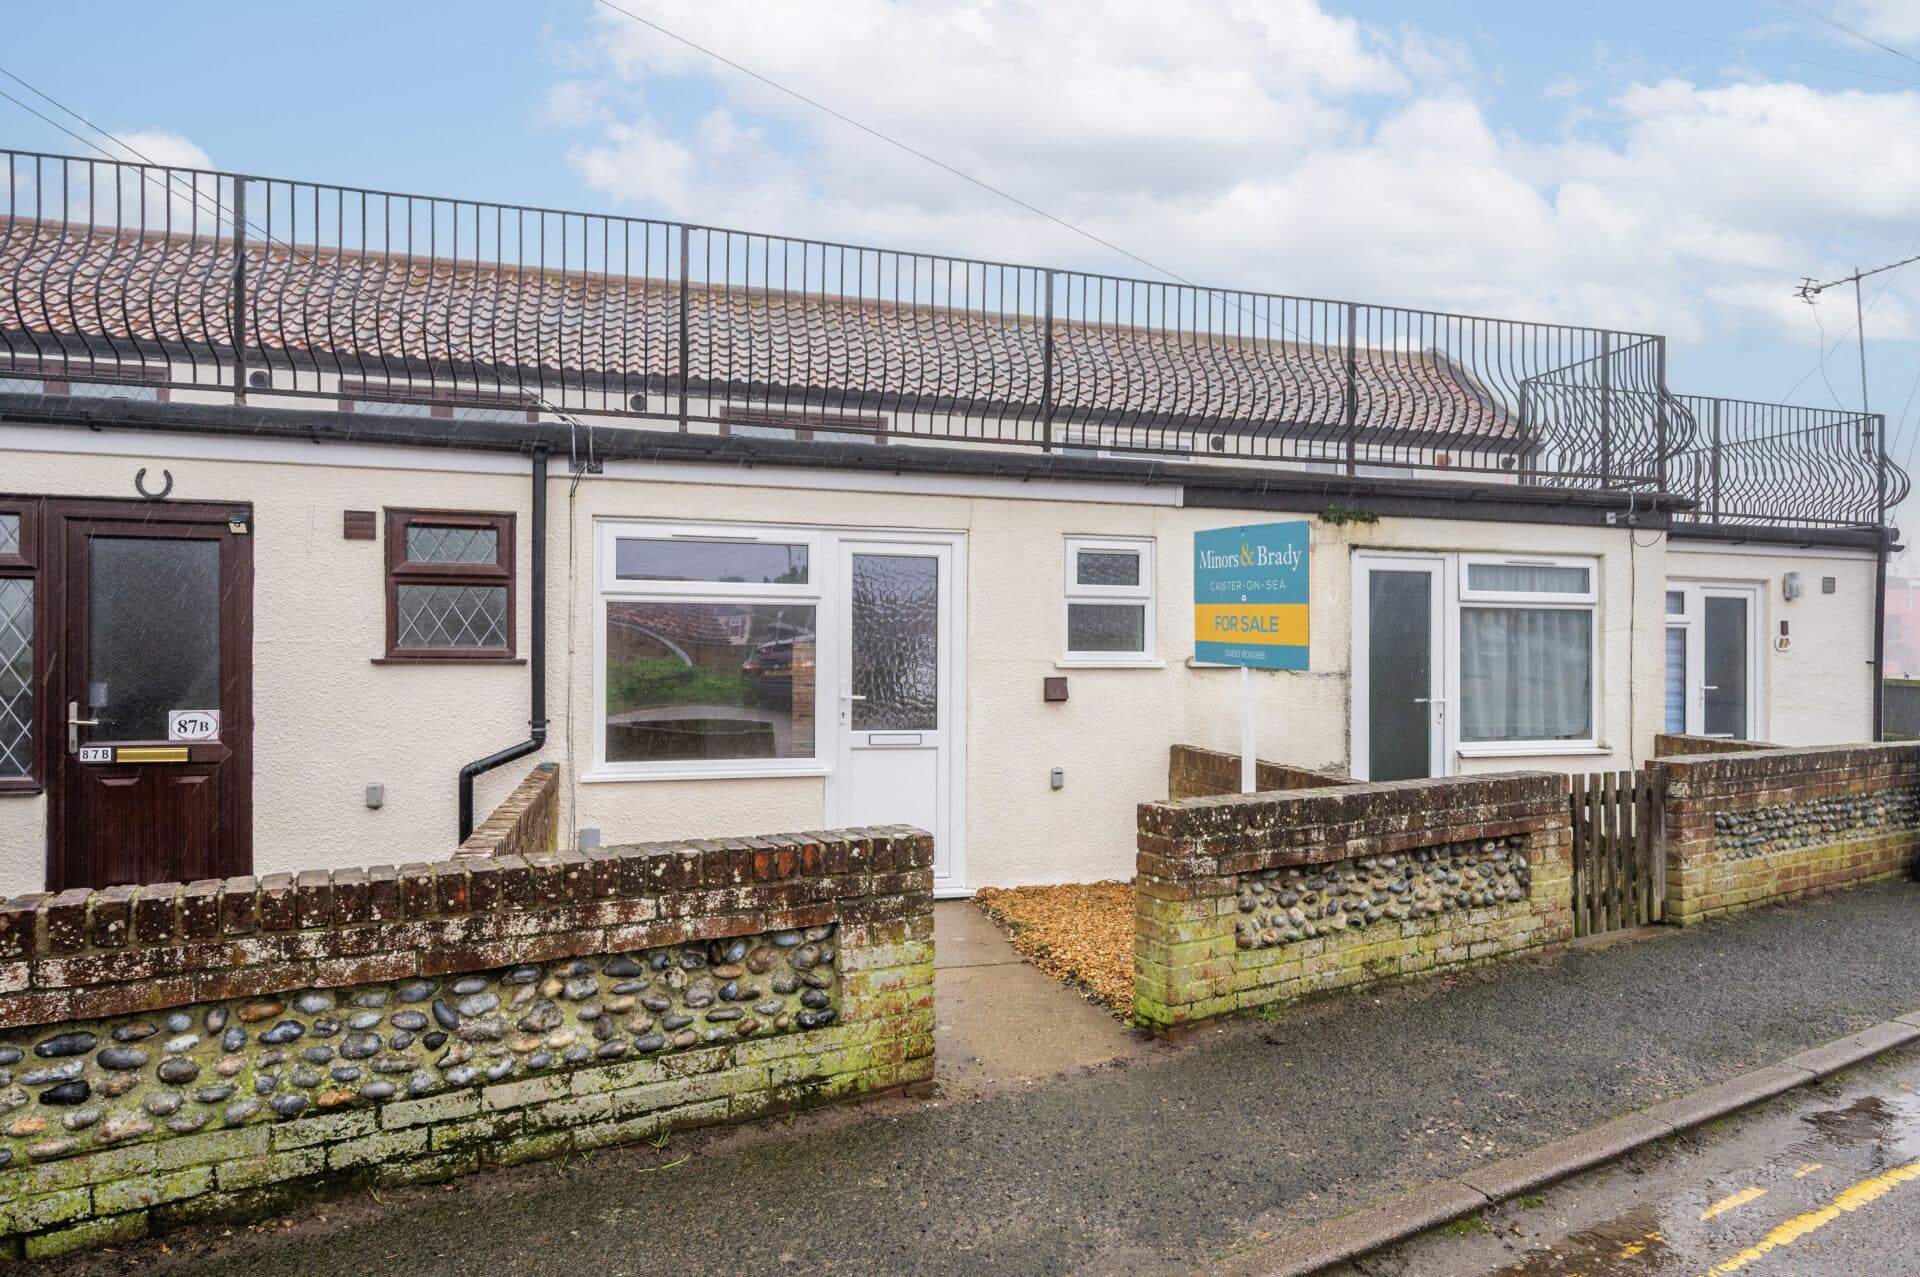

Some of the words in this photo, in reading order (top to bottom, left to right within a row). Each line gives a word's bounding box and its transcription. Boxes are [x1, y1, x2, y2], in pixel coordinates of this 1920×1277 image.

[1199, 549, 1239, 569] Minors
[1240, 542, 1255, 567] &
[1257, 543, 1302, 571] Brady
[1209, 579, 1286, 592] CAISTER-ON-SEA
[1215, 615, 1238, 632] FOR
[1240, 615, 1280, 633] SALE
[177, 719, 210, 735] 87B
